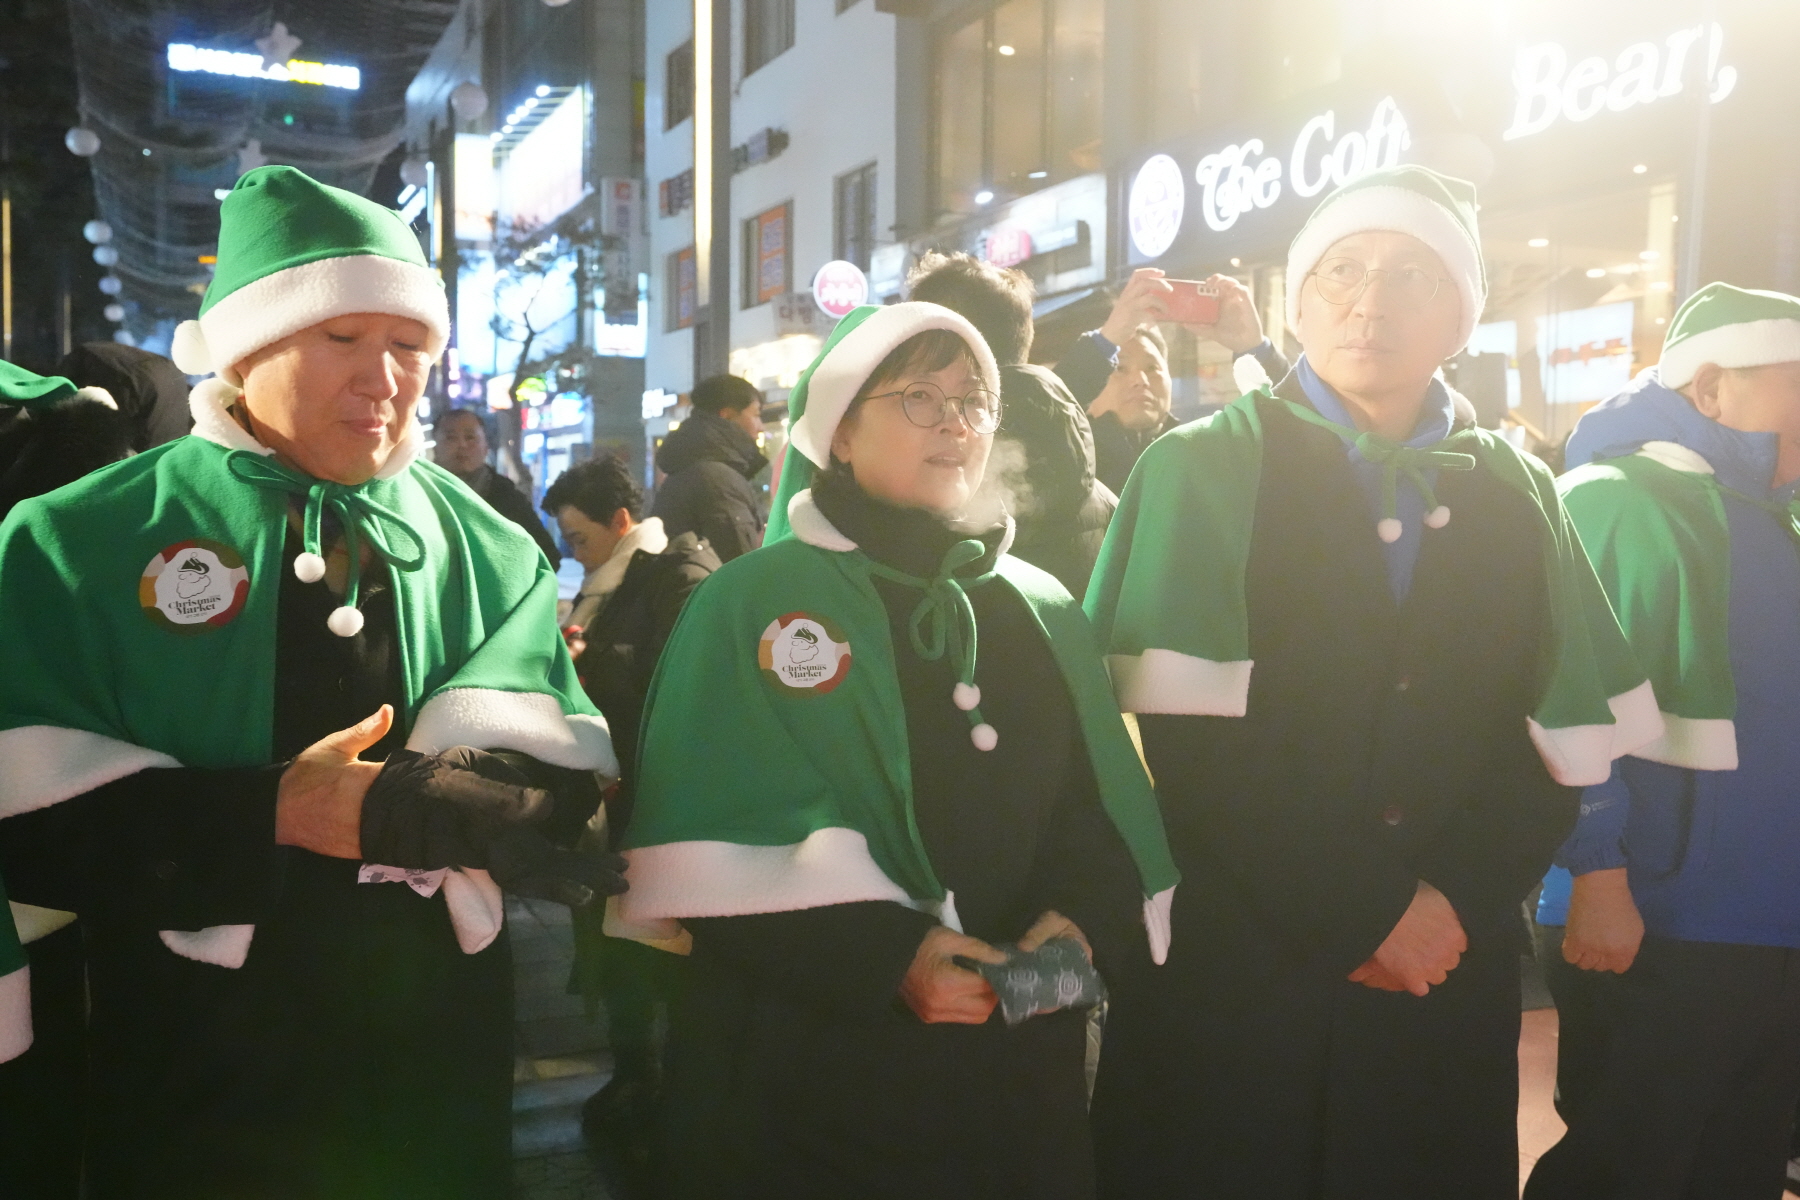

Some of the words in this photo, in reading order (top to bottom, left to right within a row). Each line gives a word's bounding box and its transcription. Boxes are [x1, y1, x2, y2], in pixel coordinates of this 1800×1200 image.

[1195, 138, 1282, 231] The
[1290, 95, 1412, 198] Coff
[168, 597, 222, 609] Christmas
[176, 603, 216, 615] Market
[782, 664, 827, 672] Christmas
[788, 670, 821, 679] Market
